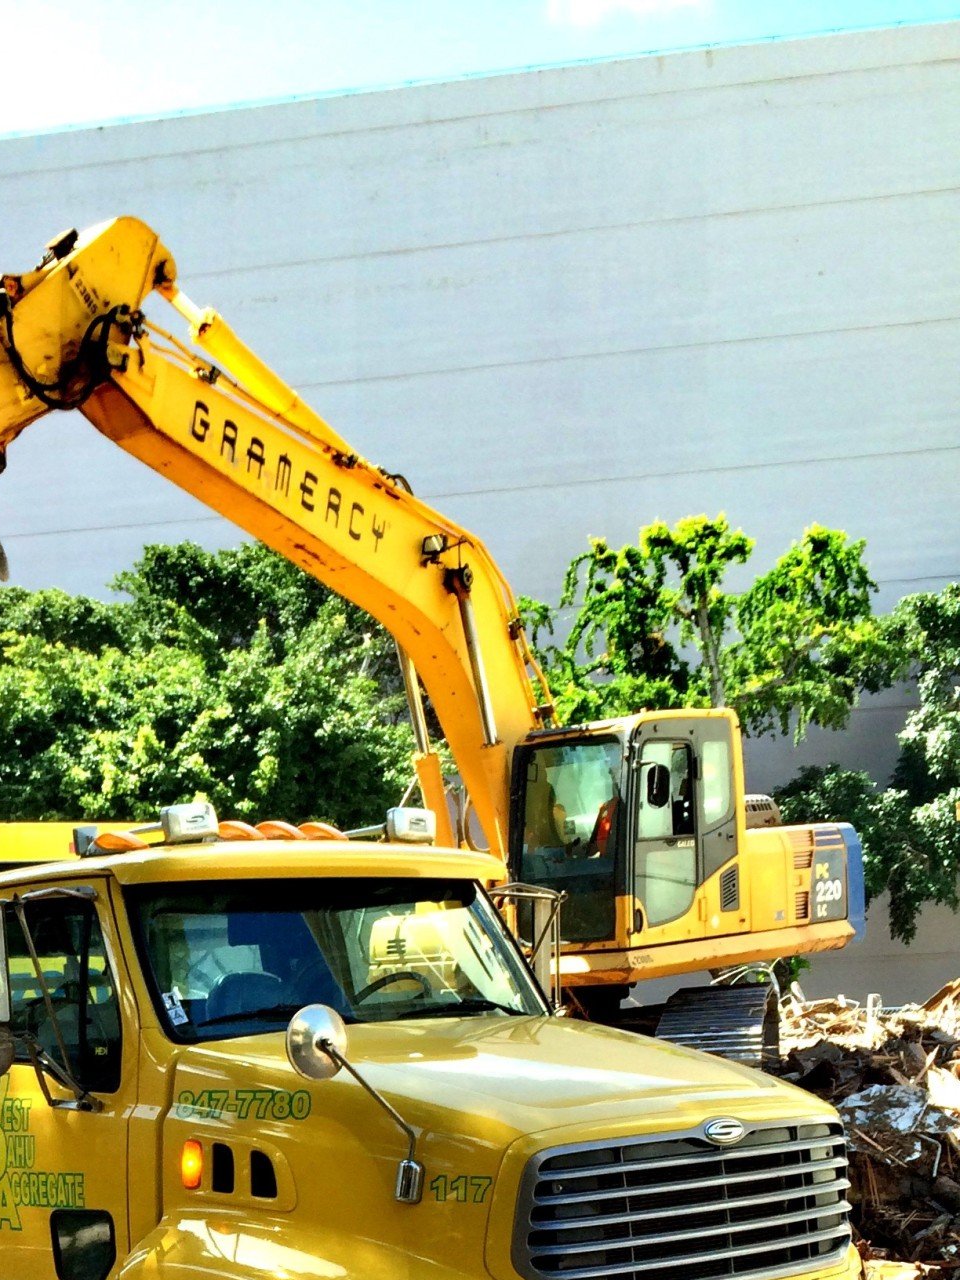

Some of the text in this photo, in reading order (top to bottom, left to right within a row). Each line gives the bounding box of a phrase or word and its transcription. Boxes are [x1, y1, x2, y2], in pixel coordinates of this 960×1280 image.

[191, 399, 387, 553] GRAMERCY
[815, 862, 829, 879] PC
[815, 879, 842, 902] 220
[817, 904, 828, 917] LC
[176, 1090, 312, 1120] 847-7780
[430, 1174, 493, 1203] 117
